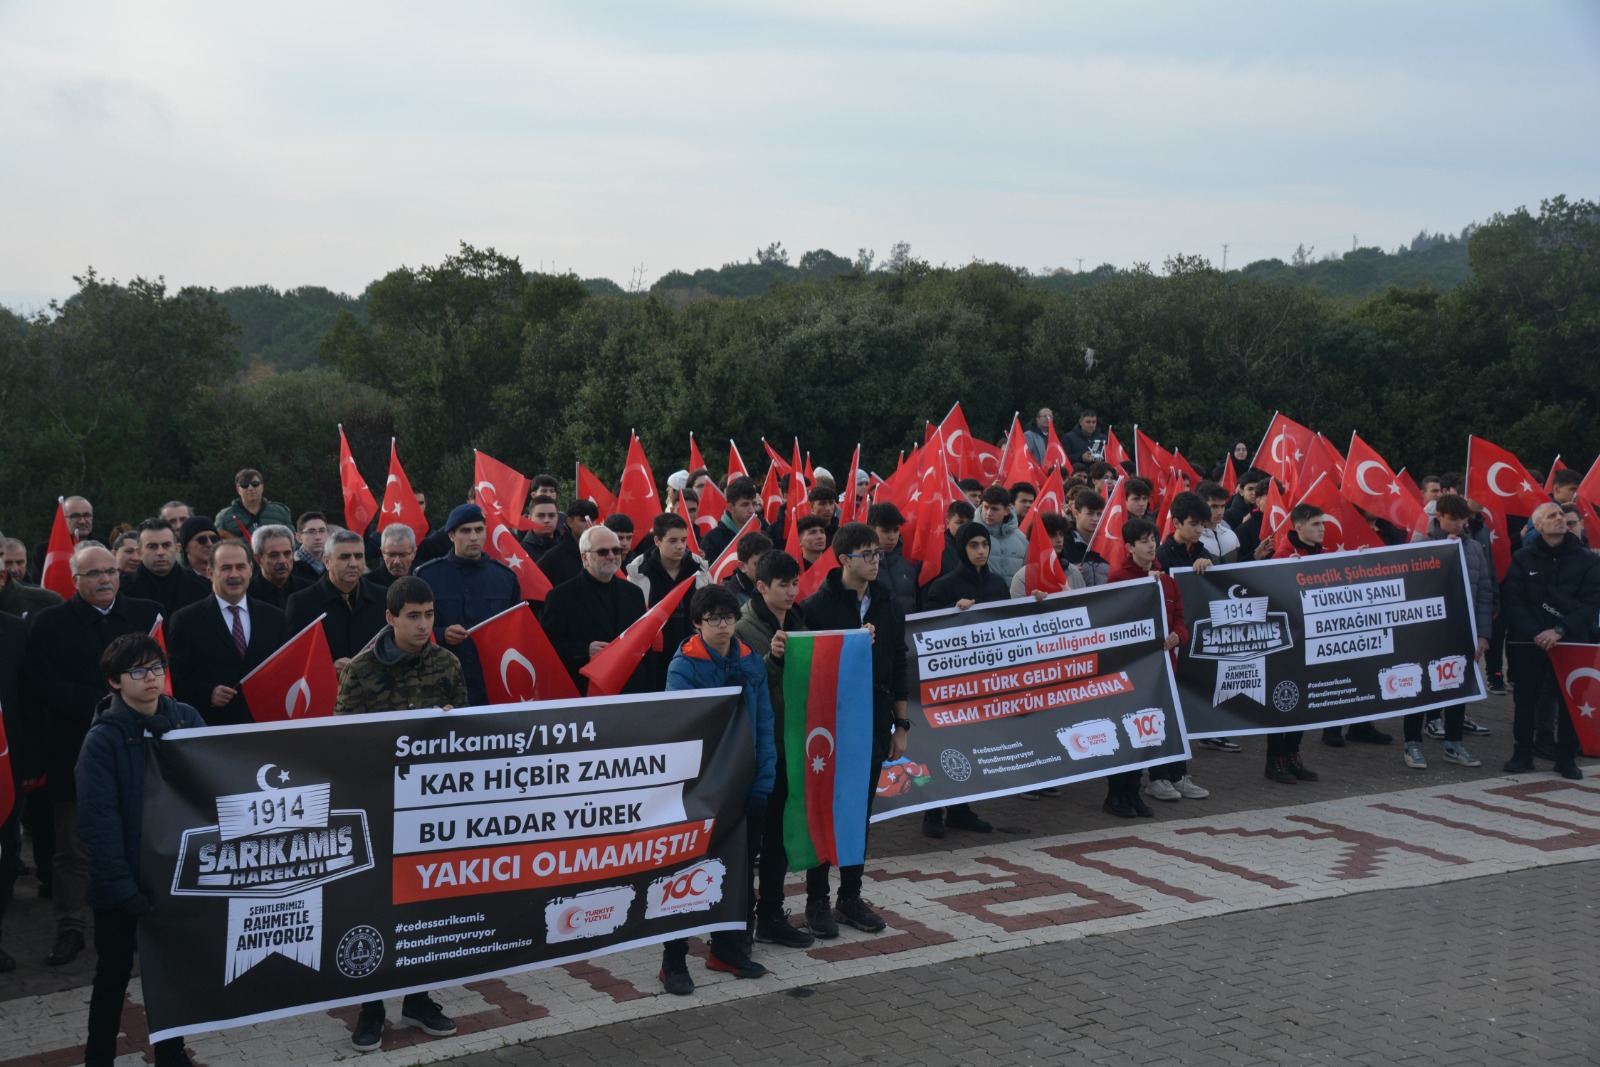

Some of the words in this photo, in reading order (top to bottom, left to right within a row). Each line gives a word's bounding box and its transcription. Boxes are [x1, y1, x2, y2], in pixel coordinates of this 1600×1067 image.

[1296, 568, 1342, 587] Gençlik
[1344, 562, 1409, 584] Şühadanın
[1411, 557, 1441, 572] izinde
[1312, 587, 1363, 607] TÜRKÜN
[1366, 584, 1401, 604] ŞANLI
[1224, 602, 1253, 620] 1914
[1316, 611, 1382, 634] BAYRAĞINI
[1385, 606, 1423, 624] TURAN
[1426, 604, 1443, 618] ELE
[971, 627, 996, 645] bizi
[998, 622, 1029, 640] karlı
[1033, 616, 1084, 635] dağlara
[1202, 622, 1281, 646] SARIKAMIŞ
[928, 648, 1003, 672] Götürdüğü
[1008, 644, 1033, 662] gün
[1036, 631, 1106, 655] kızıllığında
[1109, 623, 1152, 642] ısındık;
[1219, 641, 1267, 654] HAREKATI
[929, 681, 979, 701] VEFALI
[982, 673, 1020, 692] TÜRK
[1023, 662, 1062, 685] GELDİ
[1064, 659, 1093, 677] YİNE
[1220, 678, 1262, 691] ANIYORUZ
[1225, 669, 1259, 681] RAHMETLE
[934, 706, 980, 725] SELAM
[395, 721, 597, 757] Sarıkamış/1914
[421, 772, 475, 796] KAR
[484, 759, 570, 794] HİÇBİR
[578, 754, 666, 783] ZAMAN
[248, 794, 304, 827] 1914
[419, 820, 456, 844] BU
[466, 812, 557, 839] KADAR
[564, 802, 643, 830] YÜREK
[198, 825, 353, 873] SARIKAMIŞ
[232, 861, 325, 886] HAREKATI
[416, 855, 521, 890] YAKICI
[243, 909, 310, 933] RAHMETLE
[249, 899, 305, 917] ŞEHİTLERİMİZİ
[394, 912, 485, 934] #cedessarikamis
[236, 924, 314, 952] ANIYORUZ
[395, 928, 497, 951] #bandirmayuruyor
[395, 938, 533, 968] #bandirmadansarikamisa
